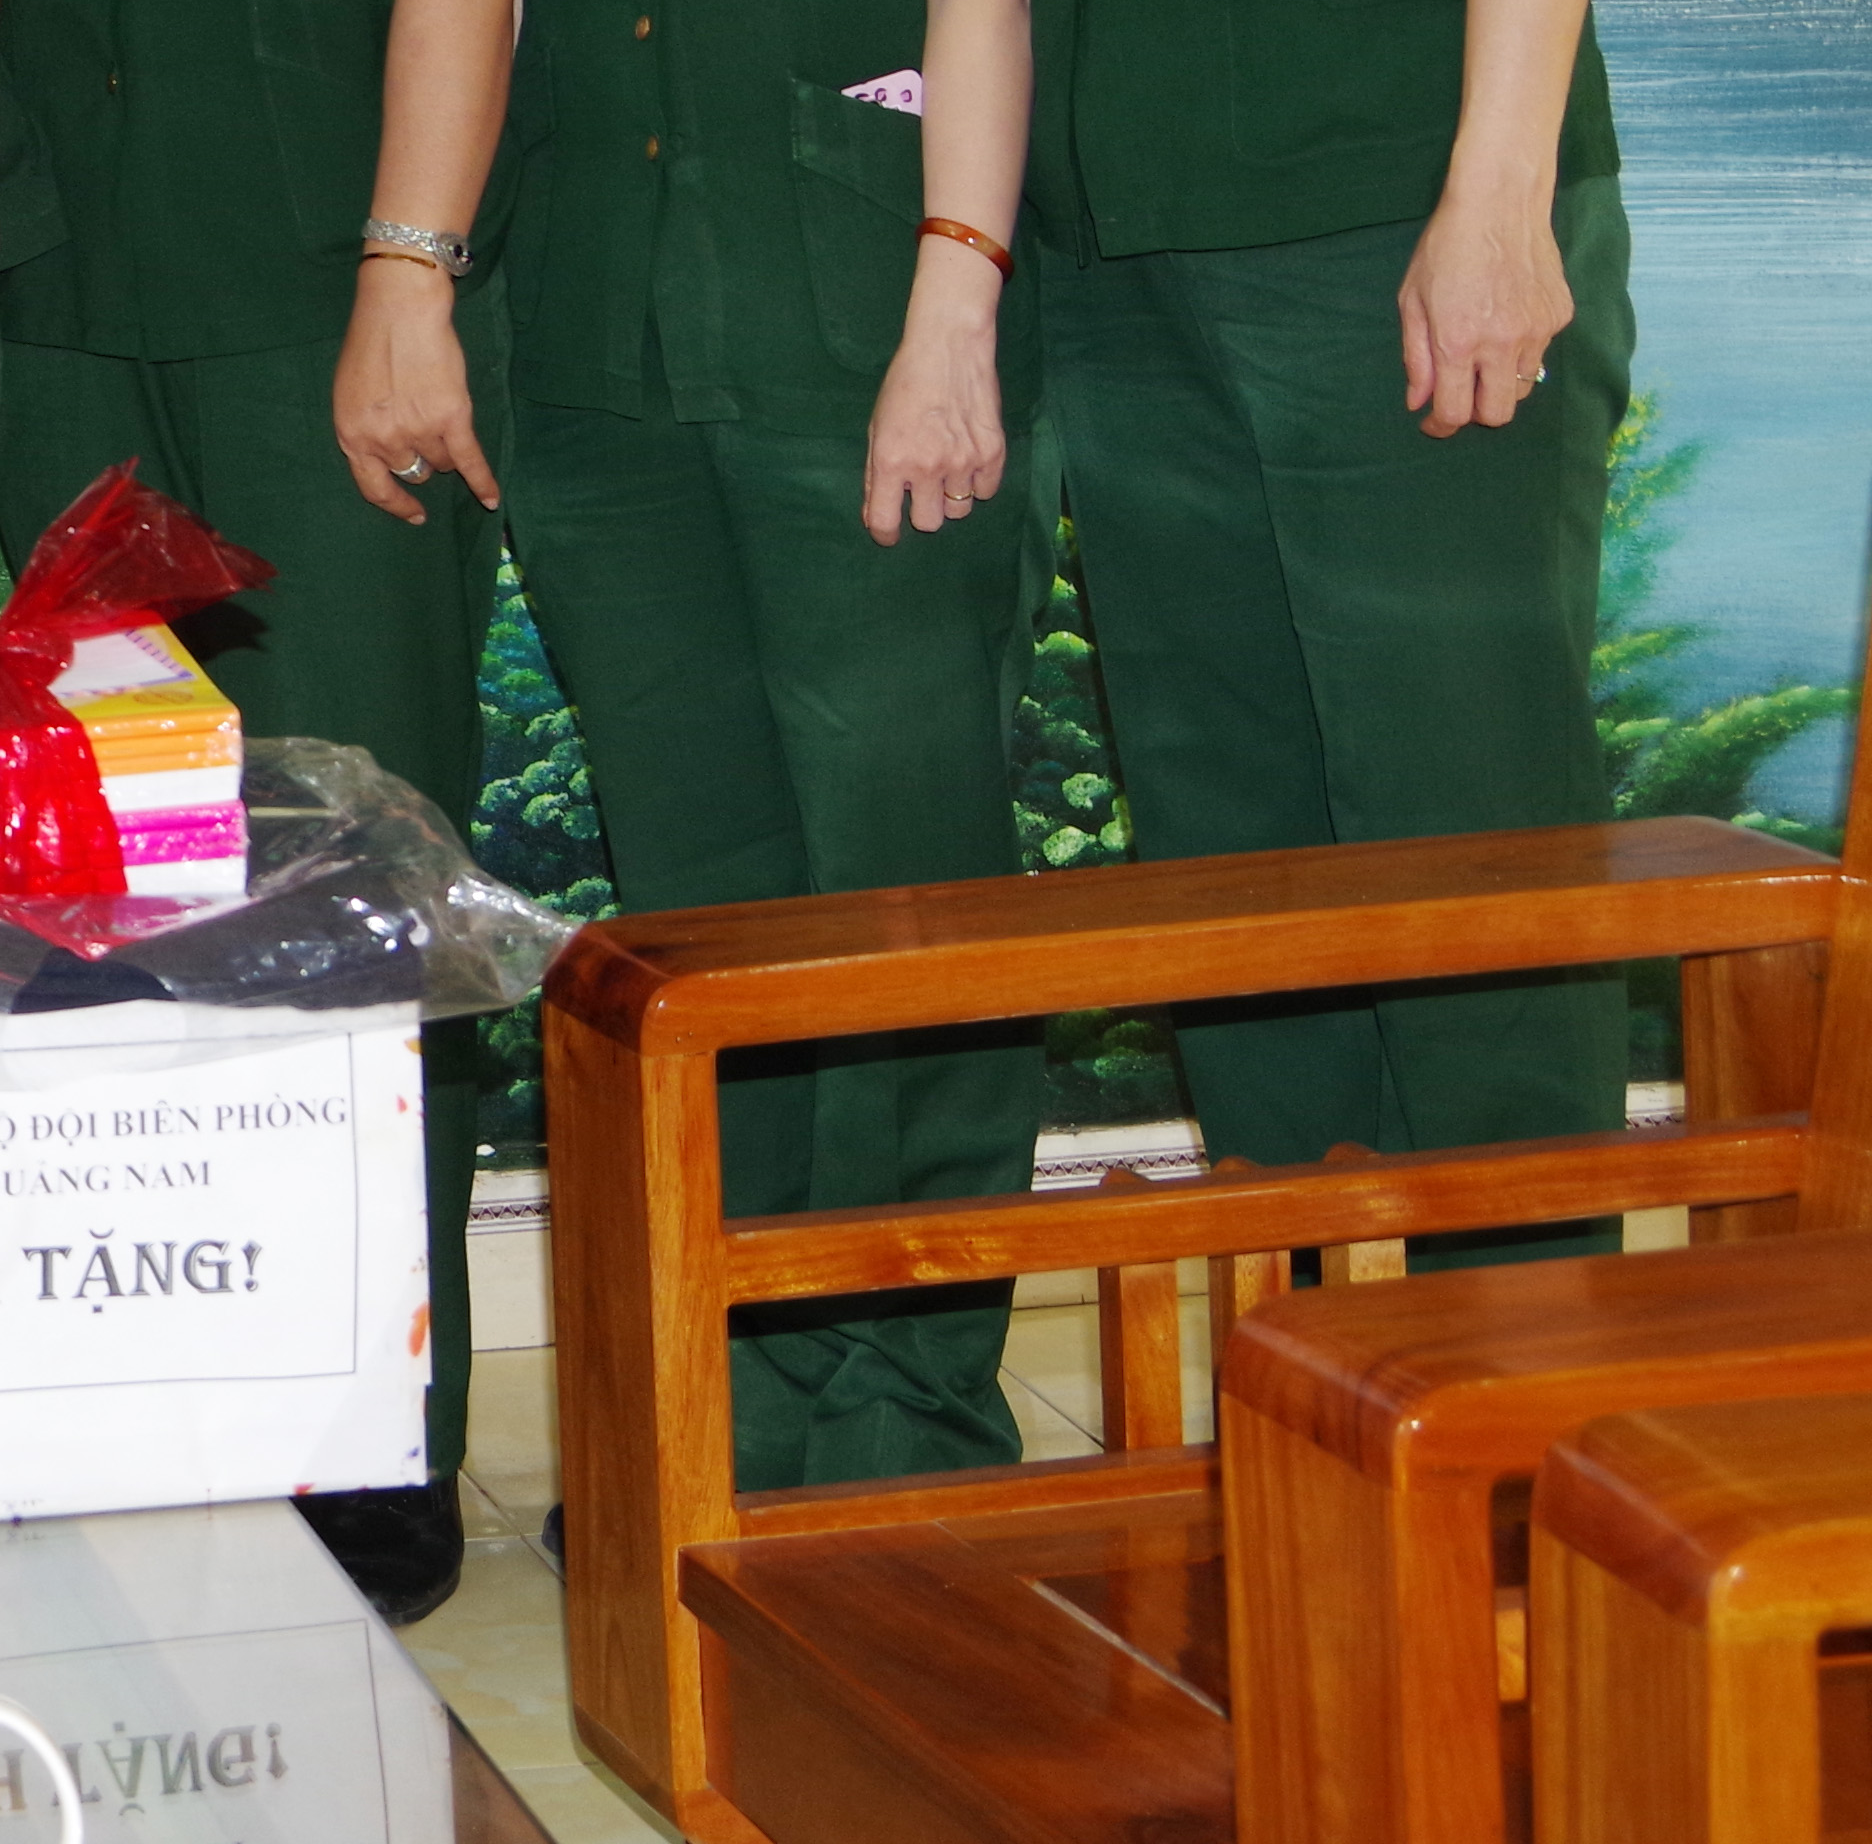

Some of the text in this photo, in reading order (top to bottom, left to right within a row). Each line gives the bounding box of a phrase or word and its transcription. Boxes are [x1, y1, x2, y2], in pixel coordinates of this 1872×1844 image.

[31, 1109, 97, 1147] ĐỘI
[113, 1100, 200, 1137] BIÊN
[216, 1093, 346, 1131] PHÒNG
[125, 1160, 210, 1189] NAM
[21, 1228, 263, 1314] TẶNG!
